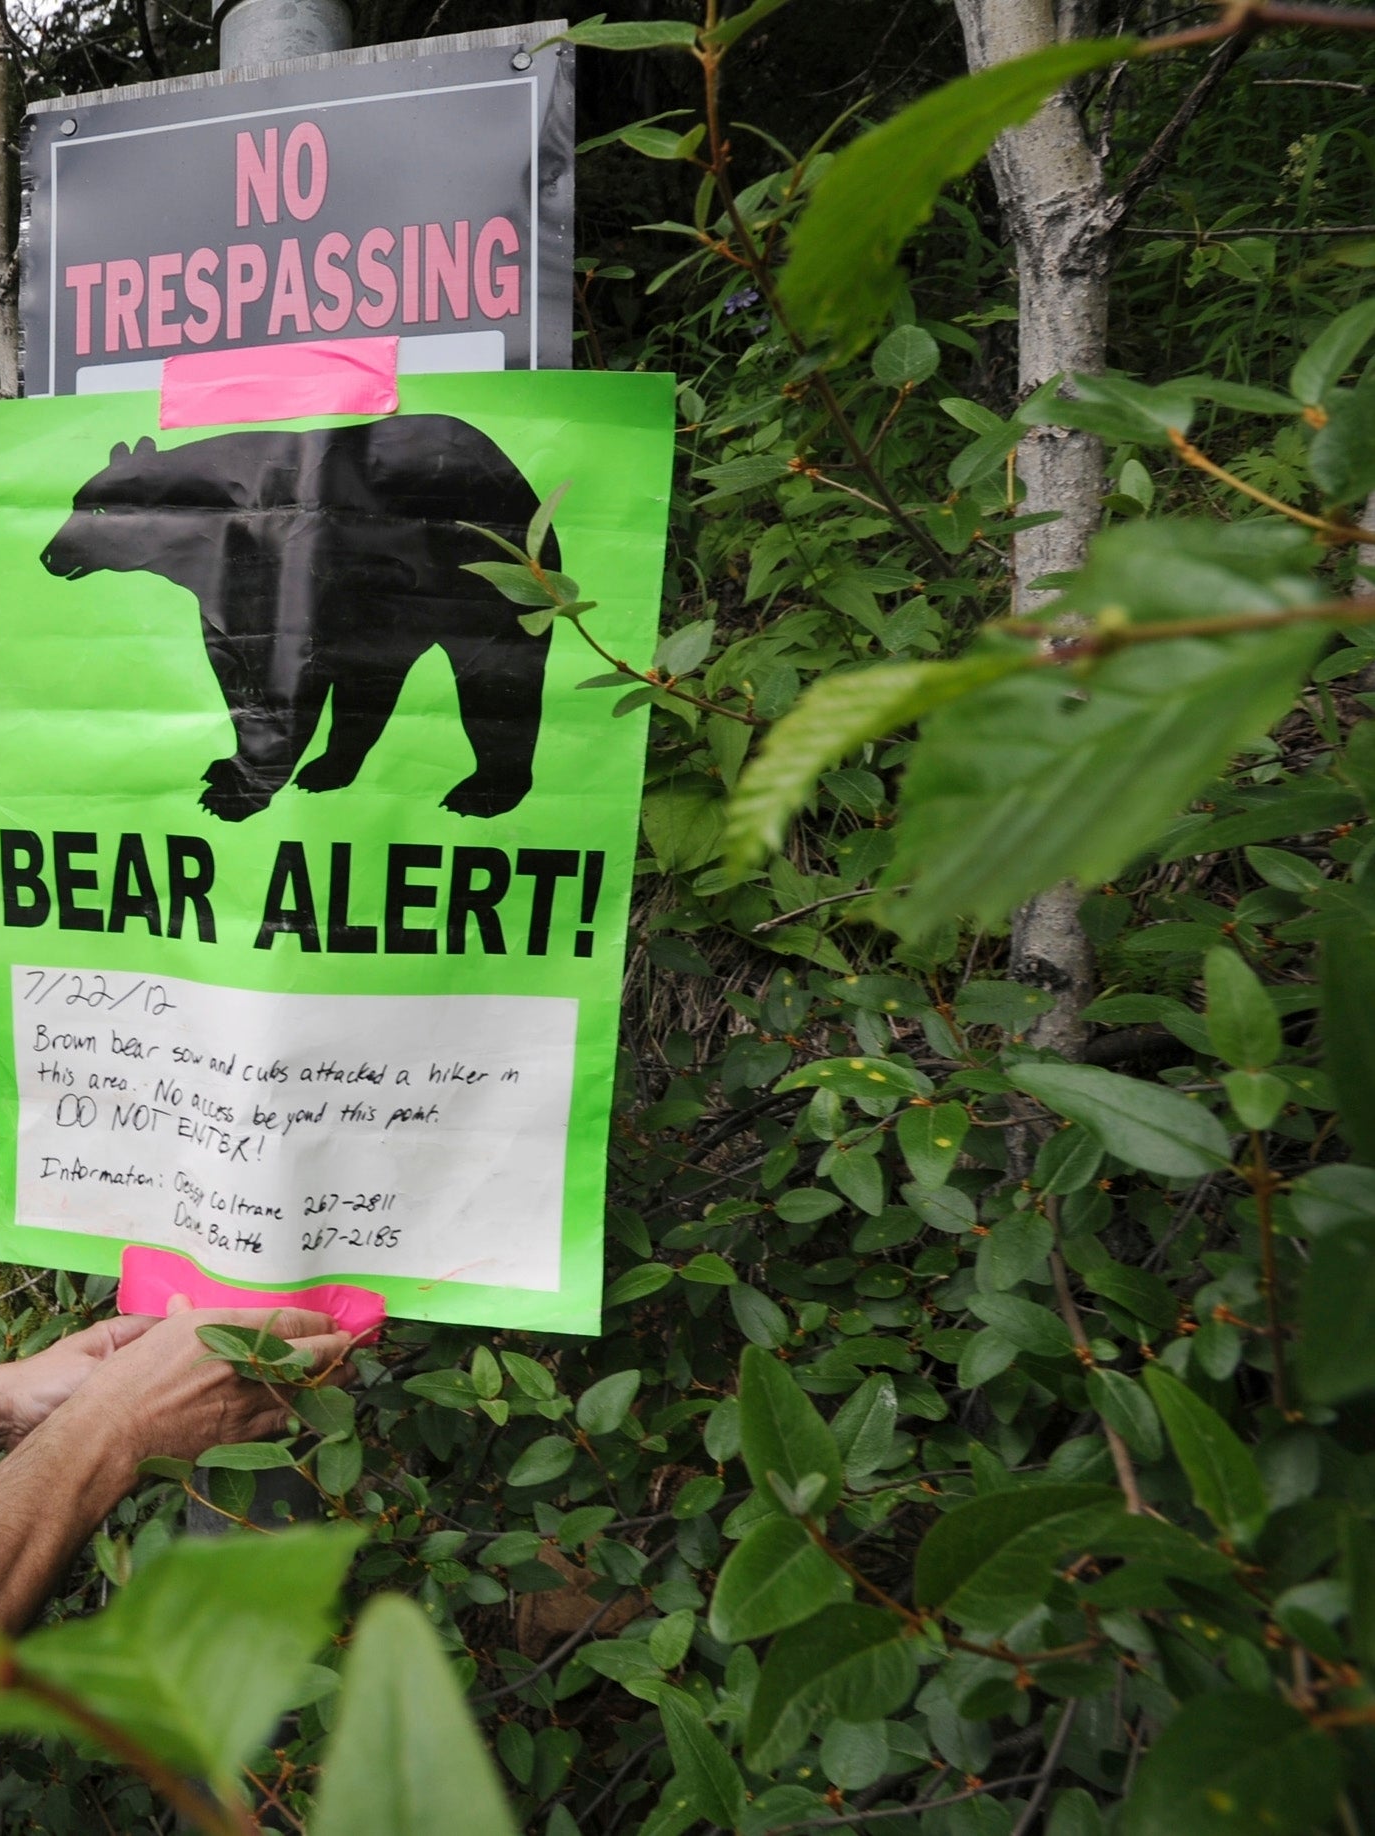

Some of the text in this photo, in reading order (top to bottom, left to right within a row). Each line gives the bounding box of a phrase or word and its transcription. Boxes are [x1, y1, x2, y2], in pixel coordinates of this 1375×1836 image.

[235, 121, 328, 228] NO
[64, 216, 521, 355] TRESPASSING
[0, 828, 605, 958] BEAR ALERT!
[24, 971, 177, 1015] 7/22/12
[33, 1024, 520, 1086] Brown bear sow and cubs attacked a hiker in
[37, 1062, 440, 1136] this area. No access beyond this point.
[56, 1093, 265, 1162] DO NOT ENTER!
[39, 1157, 163, 1188] Information:
[210, 1191, 285, 1220] Coltrane
[304, 1193, 397, 1216] 267-2811
[301, 1225, 402, 1251] 267-2185
